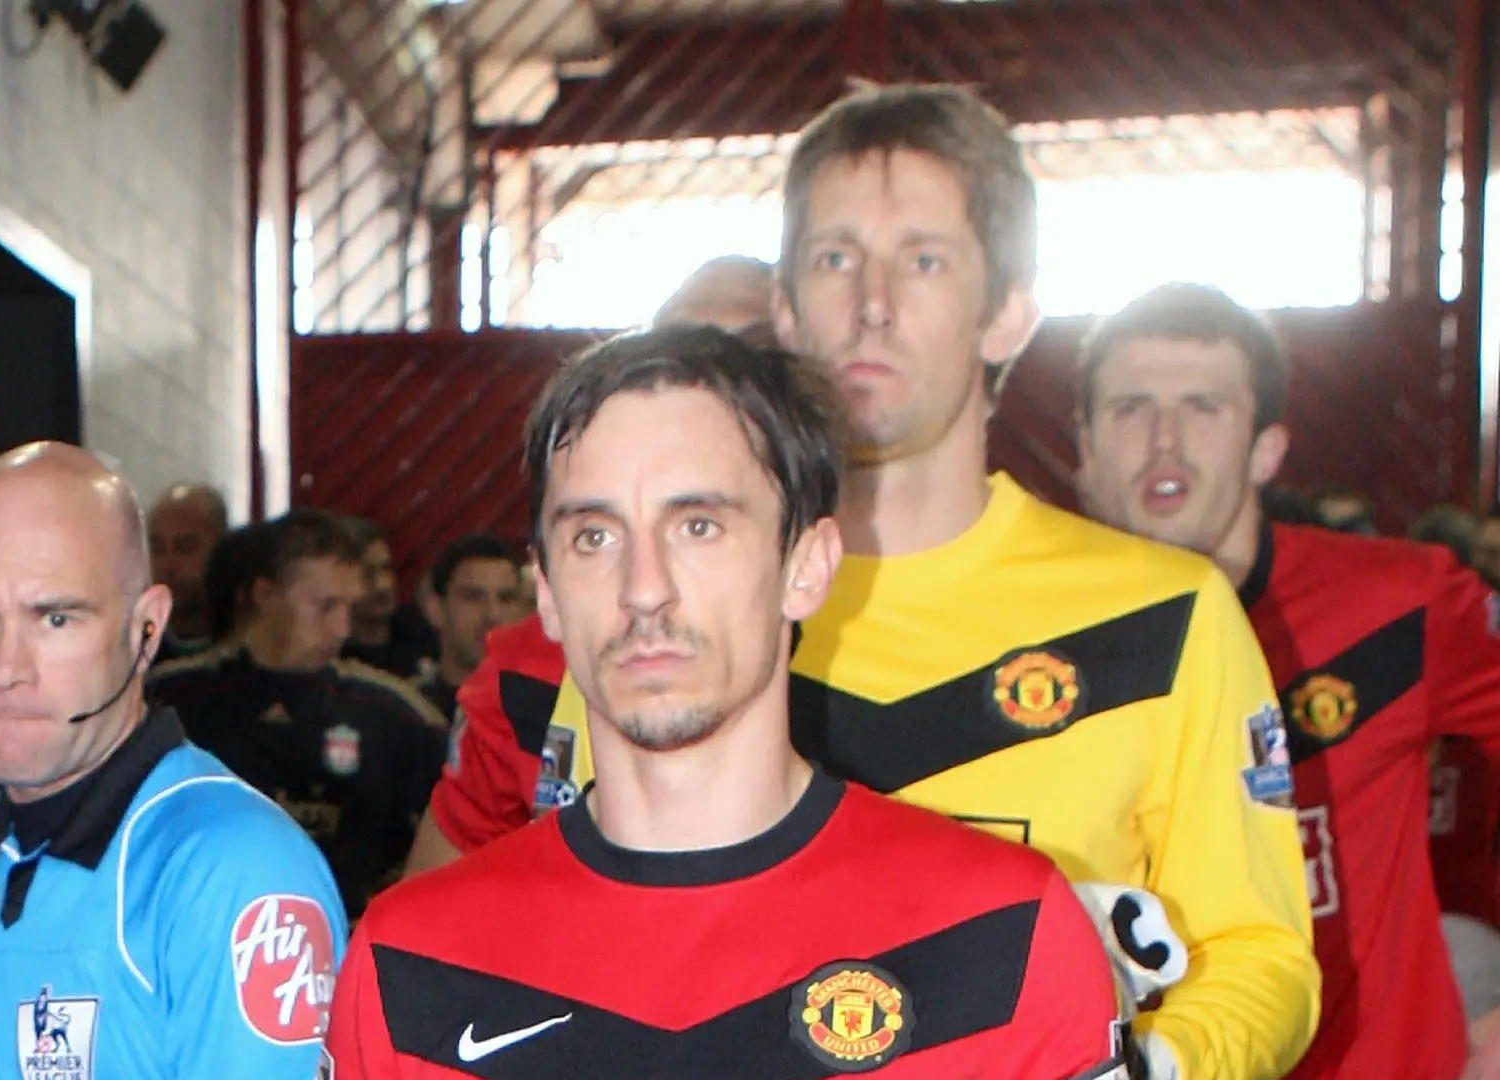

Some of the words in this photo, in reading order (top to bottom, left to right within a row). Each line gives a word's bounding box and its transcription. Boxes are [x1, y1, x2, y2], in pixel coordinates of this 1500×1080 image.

[234, 896, 307, 984] Air
[822, 1035, 881, 1055] UNITED
[25, 1055, 85, 1071] PREMIER
